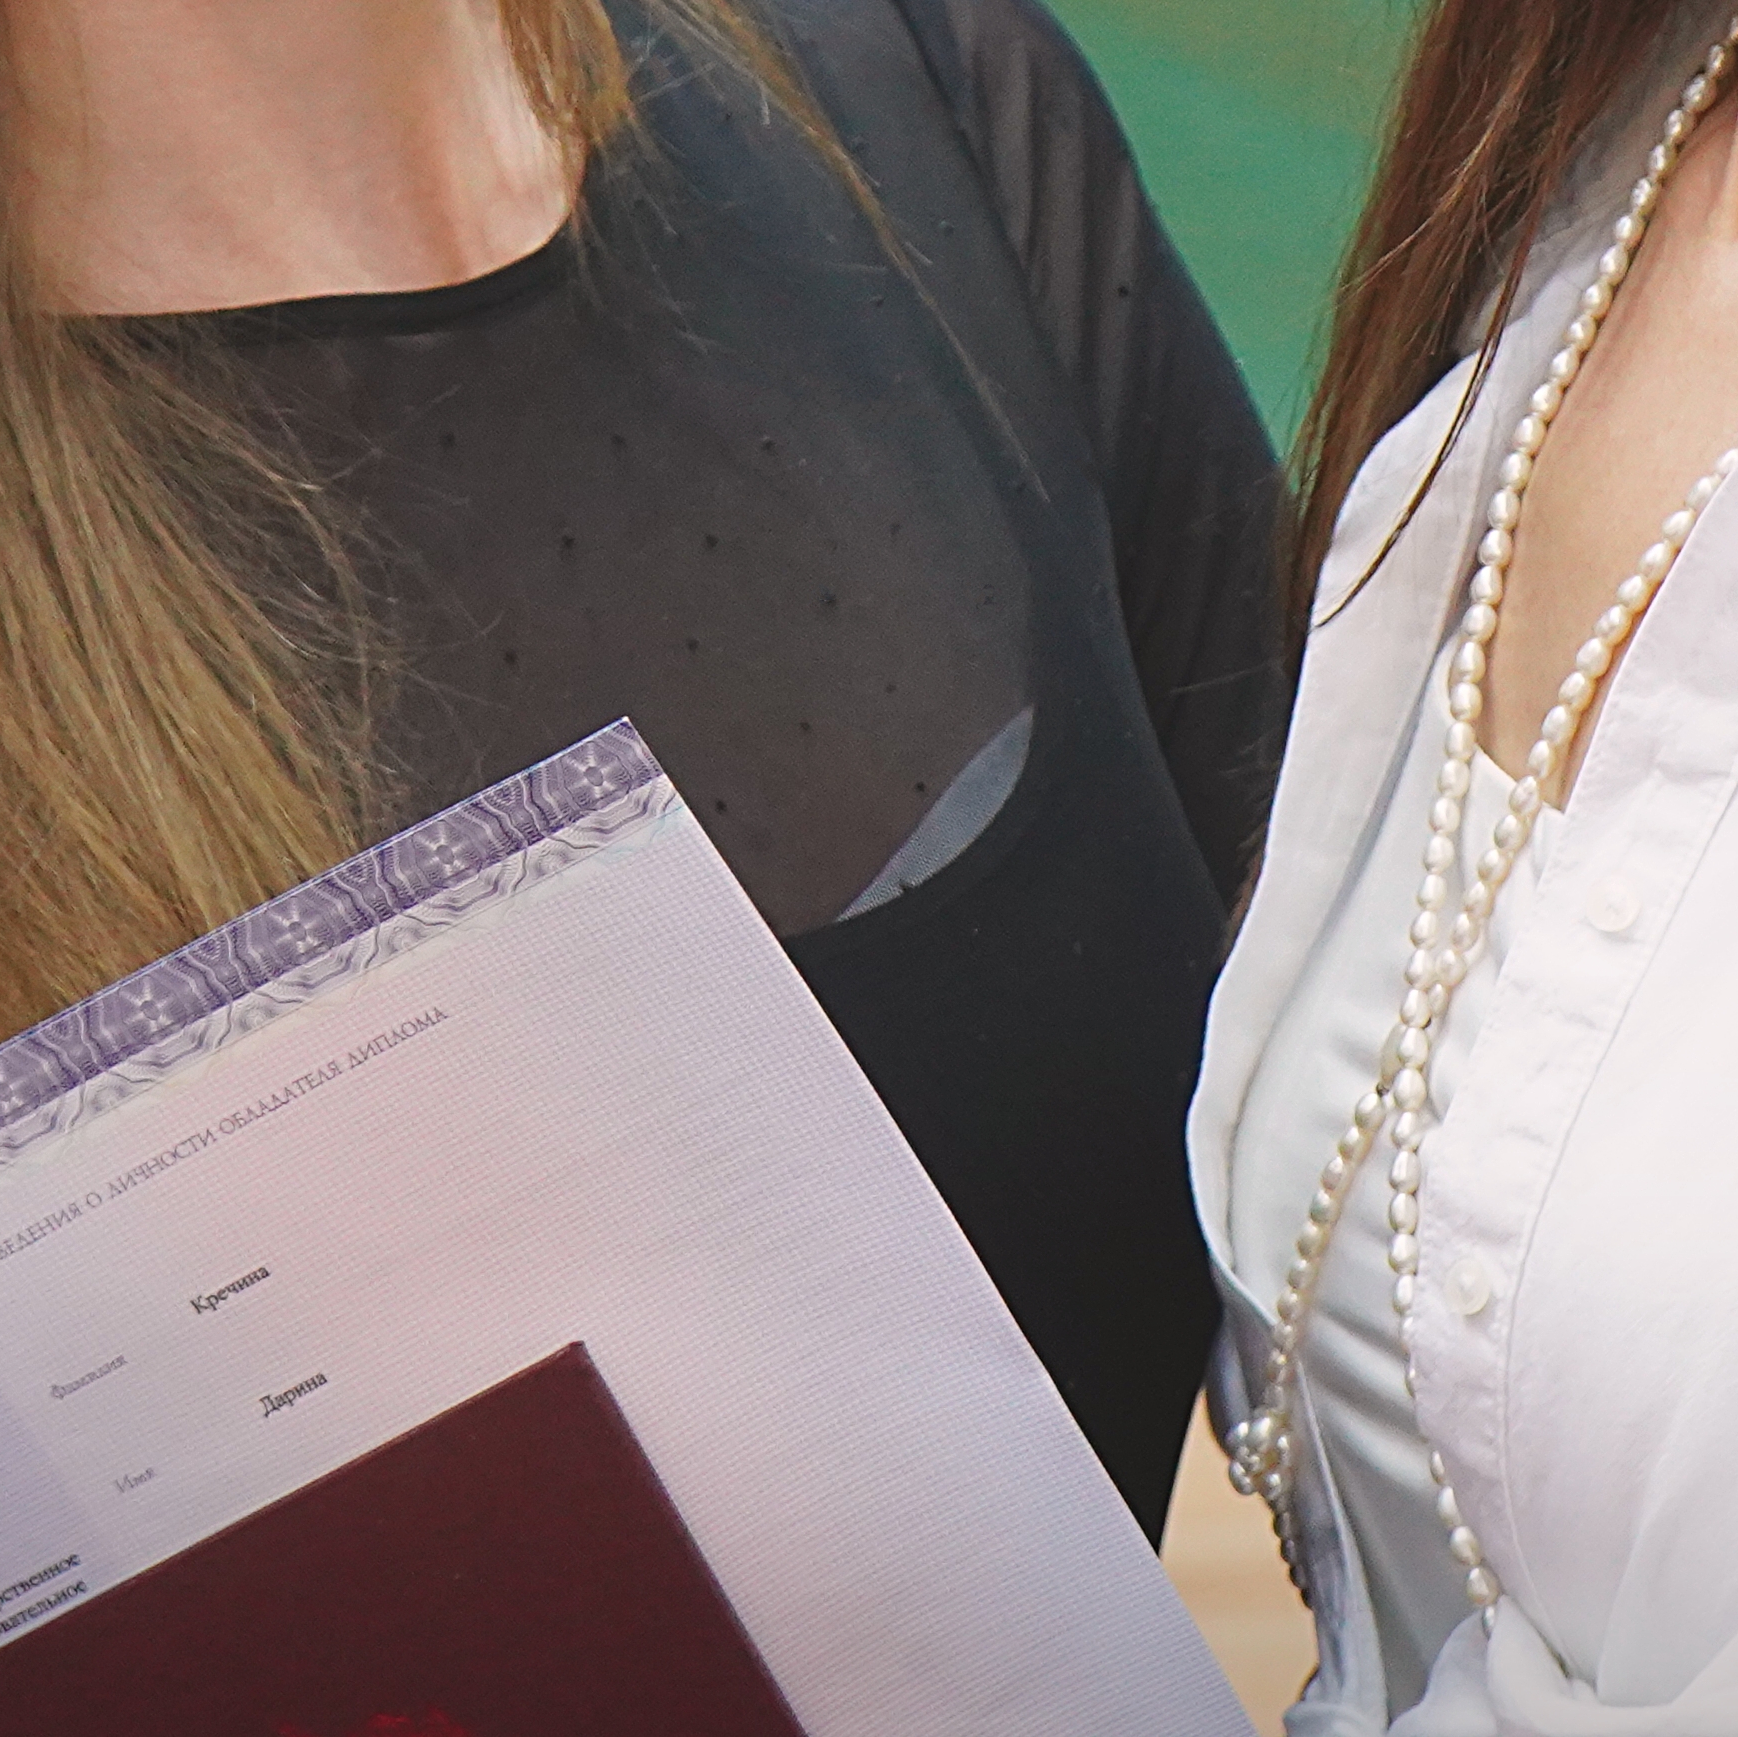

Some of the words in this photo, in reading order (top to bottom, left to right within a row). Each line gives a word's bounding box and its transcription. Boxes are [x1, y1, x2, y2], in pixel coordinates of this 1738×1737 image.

[85, 1191, 103, 1209] О
[106, 1128, 218, 1199] ЛИЧНОСТИ
[218, 1059, 343, 1135] ОБЛАДАТЕЛЯ
[347, 1006, 449, 1070] ДИПЛОМА
[189, 1265, 272, 1315] Кречина
[258, 1371, 329, 1418] Дарина
